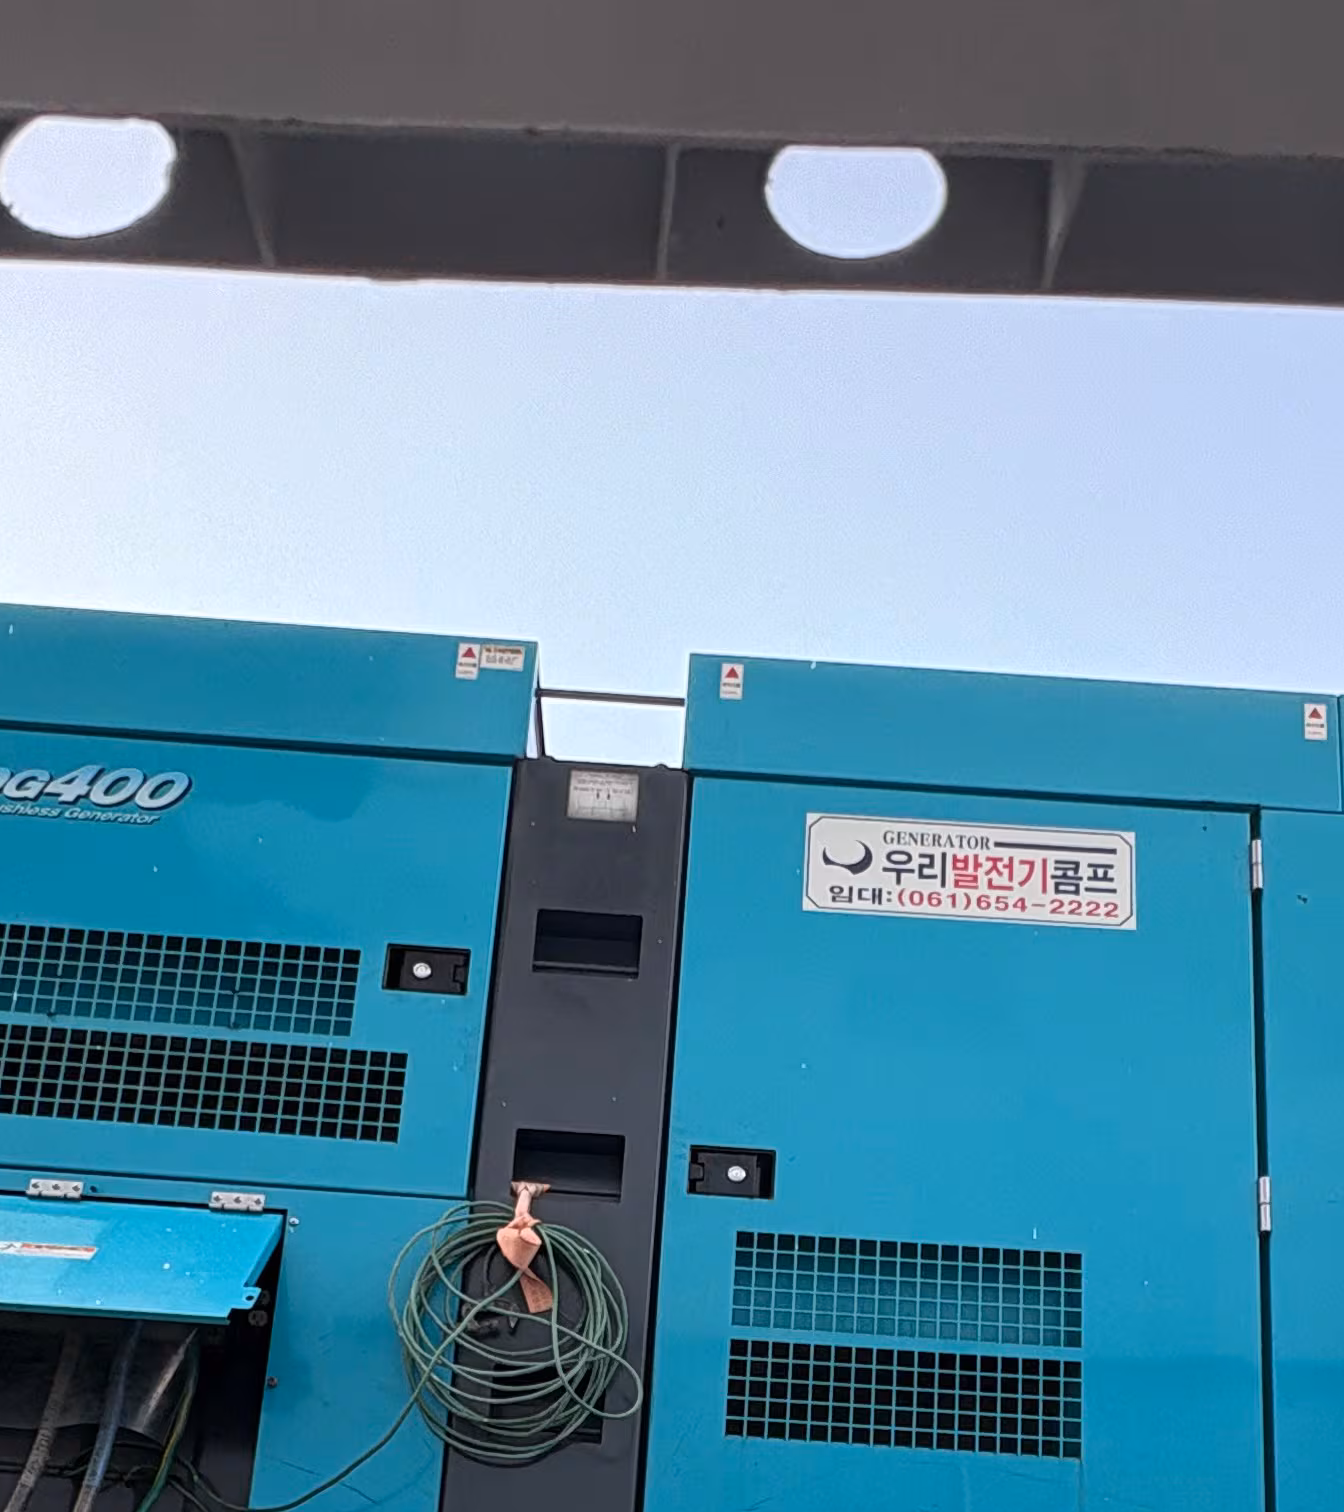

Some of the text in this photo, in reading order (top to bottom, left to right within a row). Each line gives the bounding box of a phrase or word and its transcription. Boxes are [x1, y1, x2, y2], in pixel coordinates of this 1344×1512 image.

[63, 807, 160, 825] Generator
[882, 829, 991, 851] GENERATOR
[882, 849, 1118, 896] 우리발전기콤프
